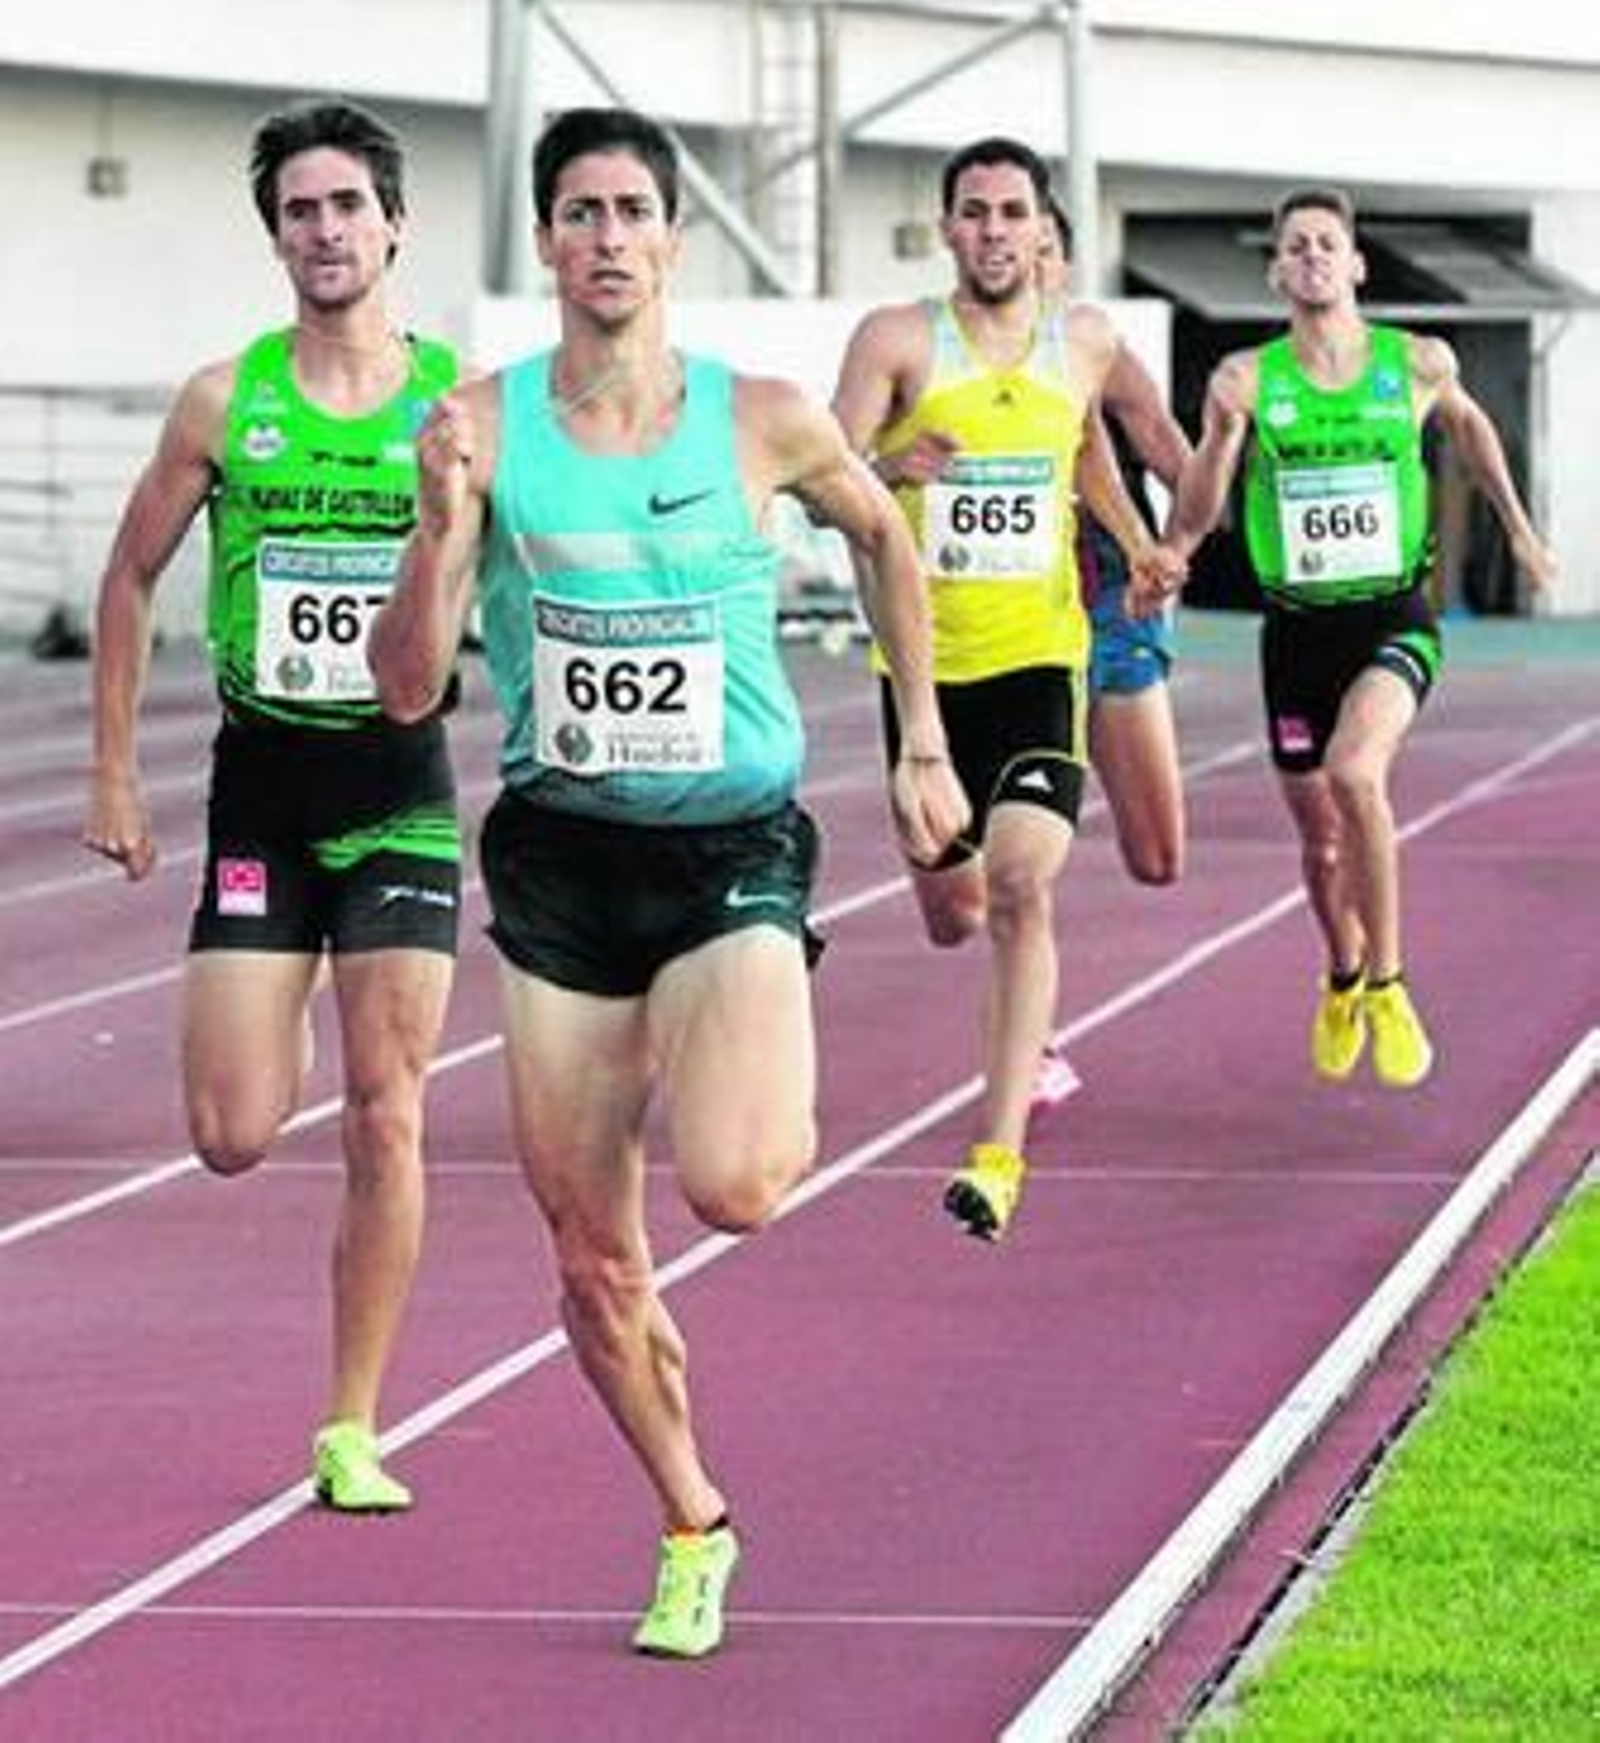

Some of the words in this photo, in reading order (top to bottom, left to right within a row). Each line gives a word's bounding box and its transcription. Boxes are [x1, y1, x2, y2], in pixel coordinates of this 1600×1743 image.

[952, 494, 1036, 534] 665
[1303, 501, 1379, 540] 666
[565, 656, 686, 714] 662
